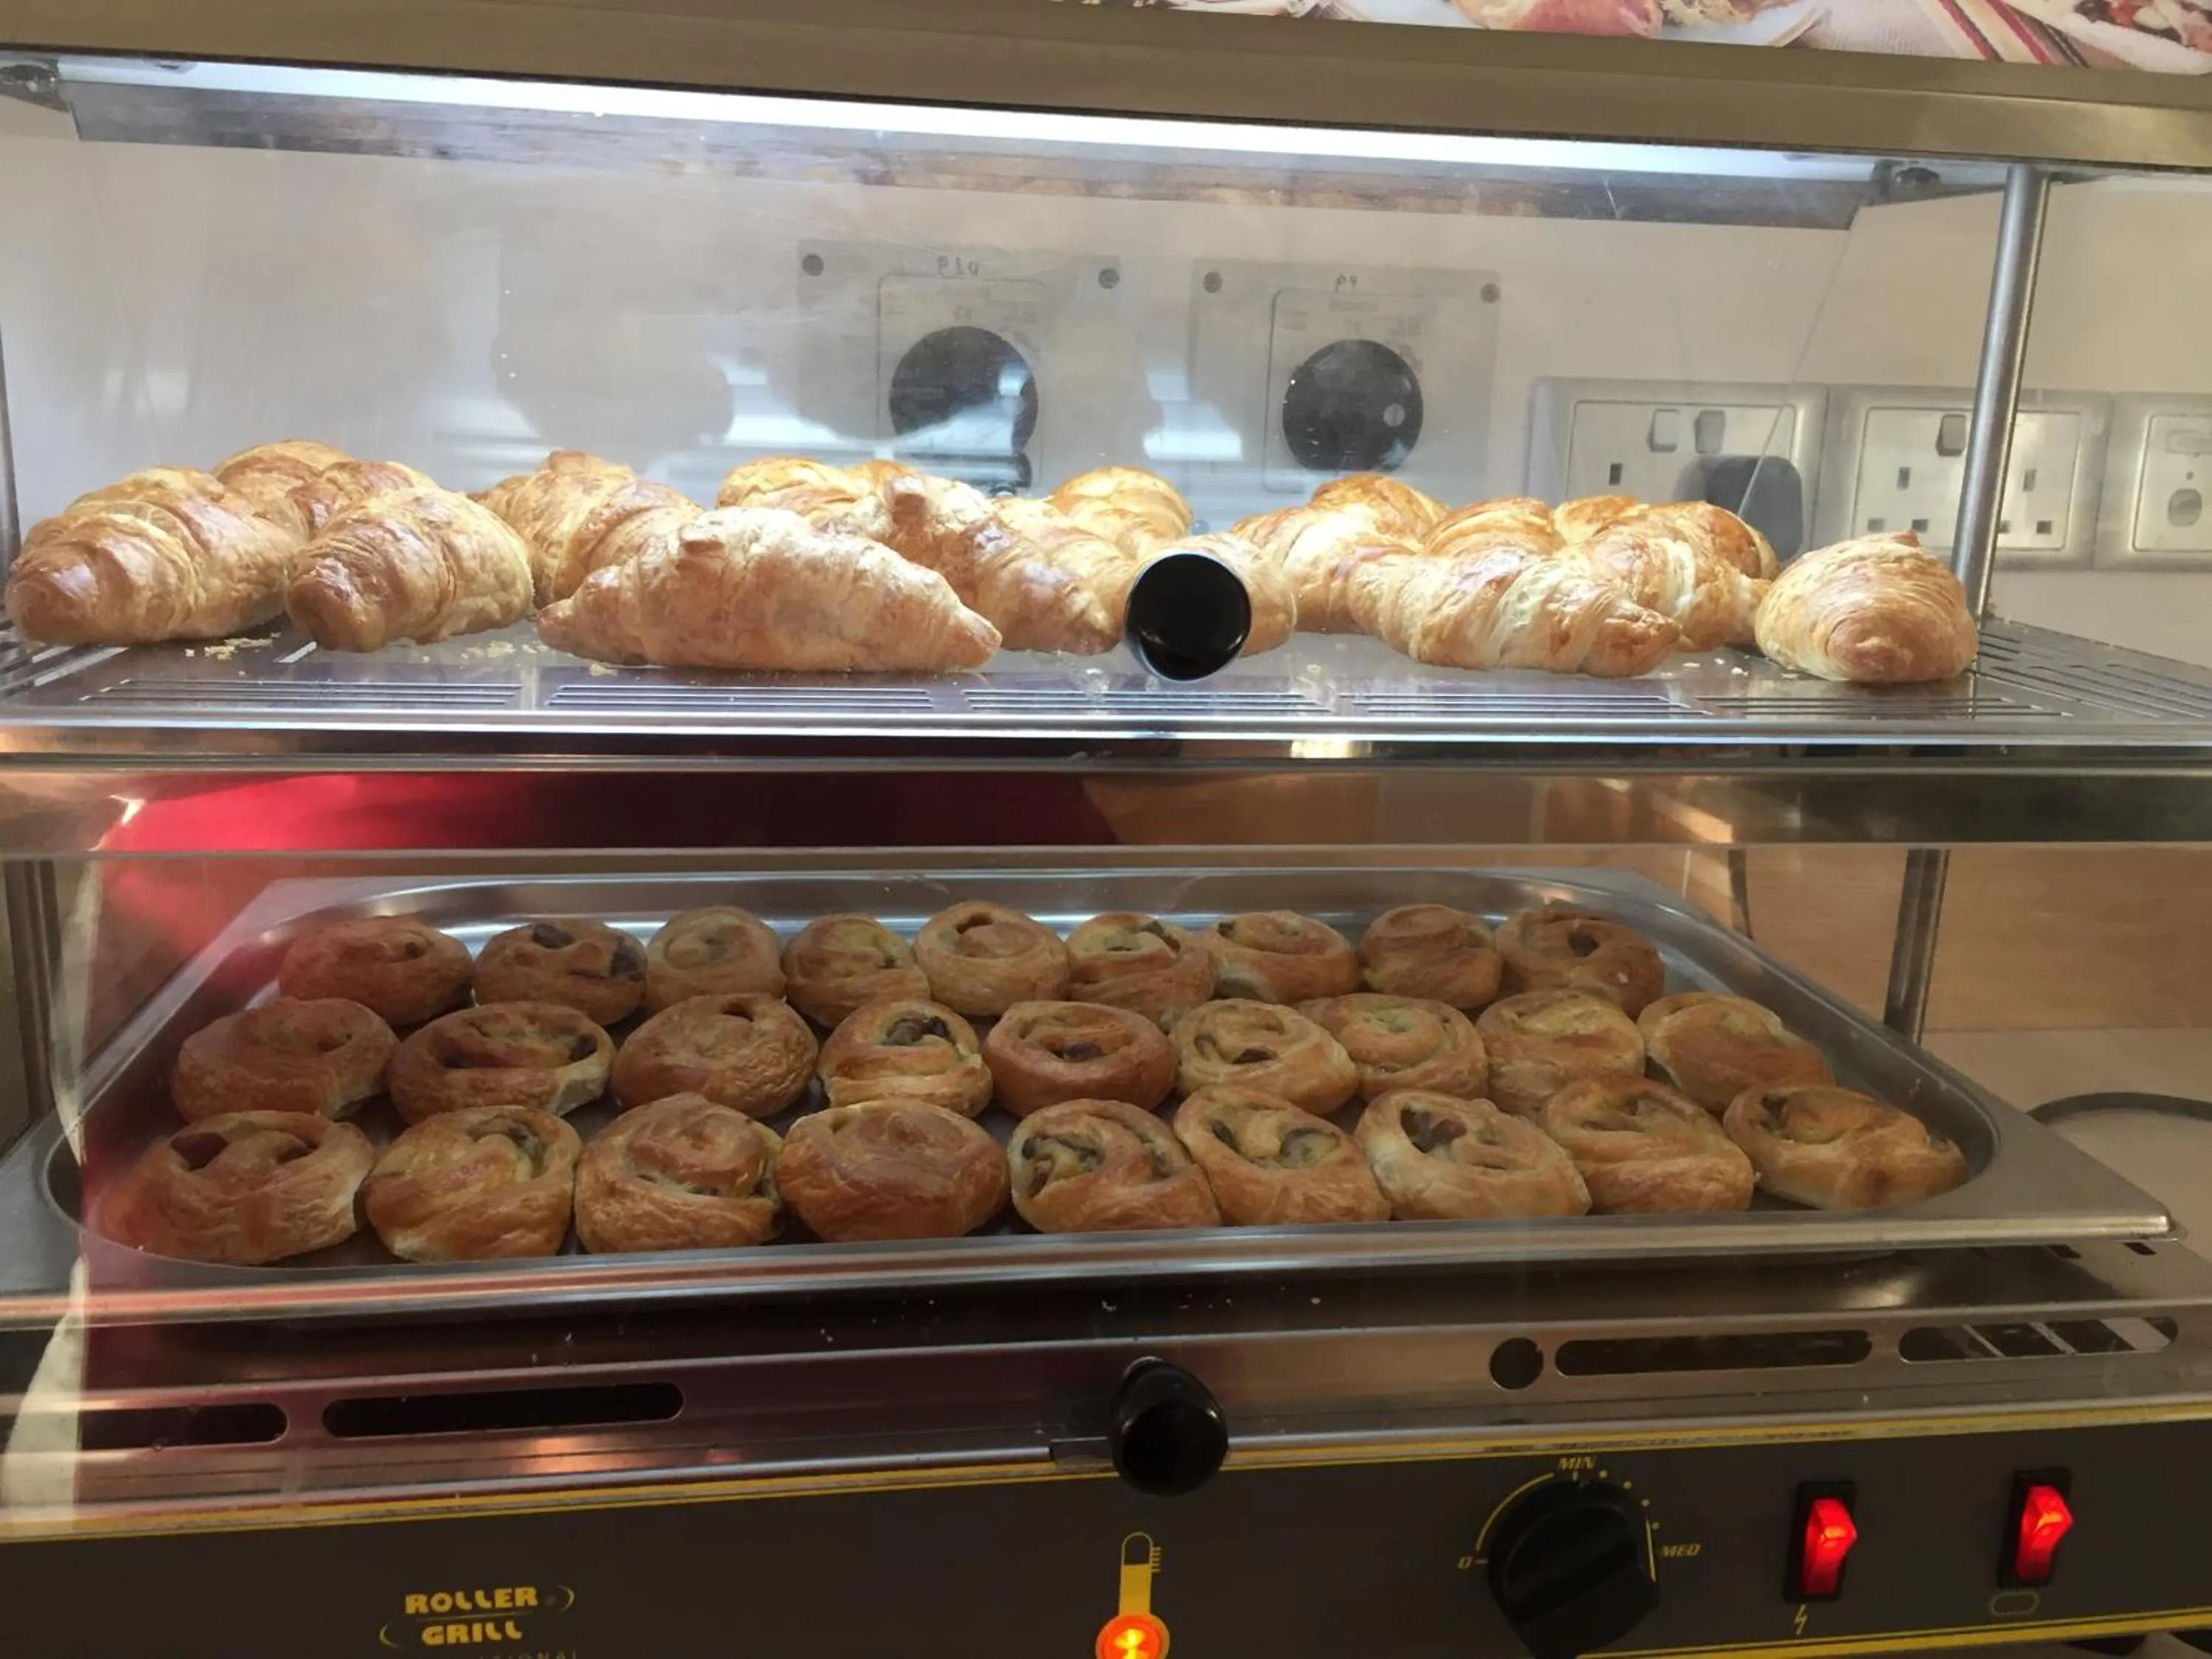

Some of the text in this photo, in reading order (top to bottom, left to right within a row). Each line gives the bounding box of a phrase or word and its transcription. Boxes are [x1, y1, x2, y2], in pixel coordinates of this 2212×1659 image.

[1557, 1457, 1596, 1470] MIN
[406, 1587, 538, 1613] ROLLER
[421, 1621, 523, 1646] GRILL
